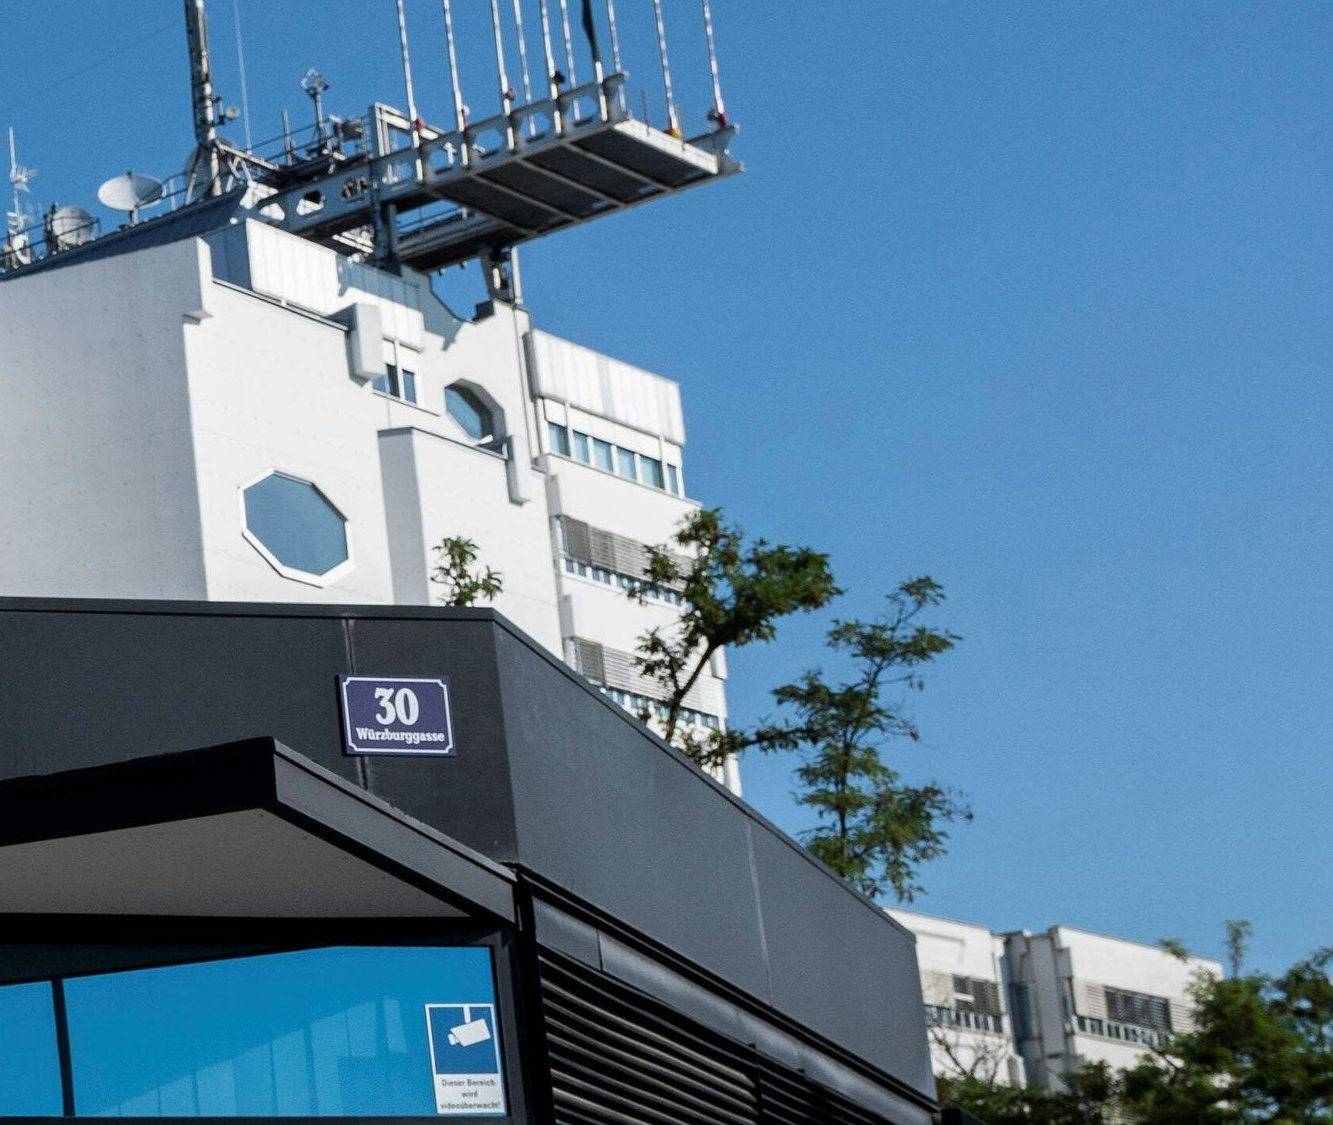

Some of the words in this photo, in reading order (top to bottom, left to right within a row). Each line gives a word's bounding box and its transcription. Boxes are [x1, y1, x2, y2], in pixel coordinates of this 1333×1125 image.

[374, 687, 420, 725] 30
[355, 727, 446, 744] Würzburggasse
[441, 1079, 465, 1087] Dieser
[466, 1078, 495, 1087] Bereich
[461, 1090, 478, 1098] wird
